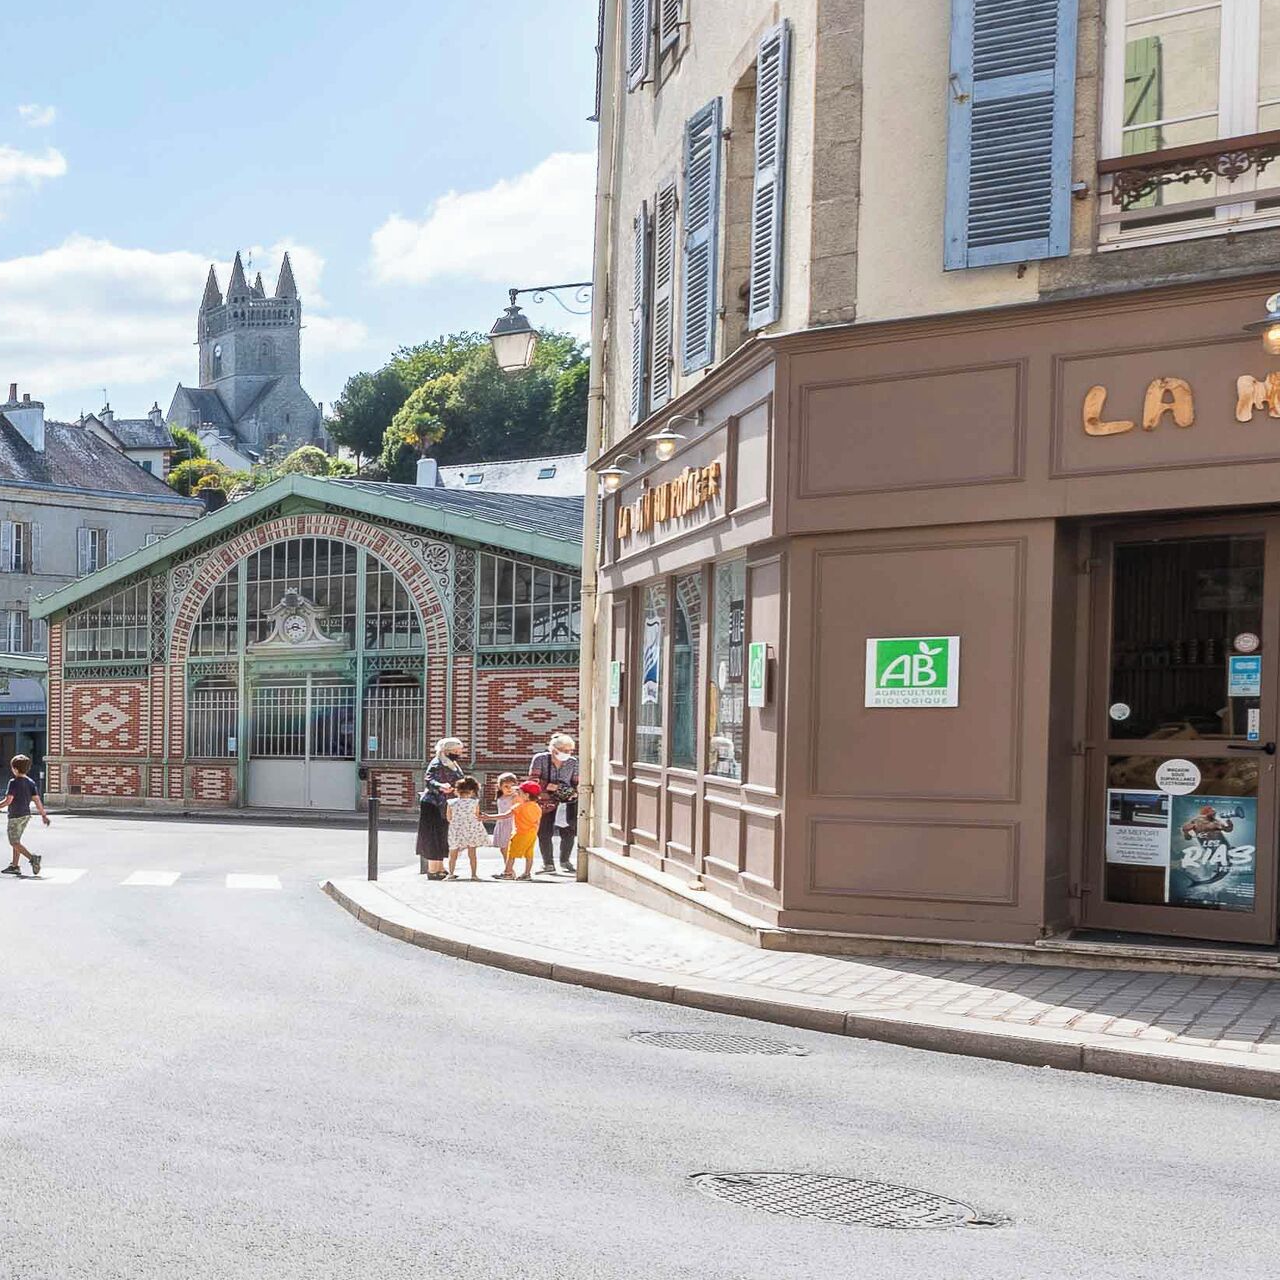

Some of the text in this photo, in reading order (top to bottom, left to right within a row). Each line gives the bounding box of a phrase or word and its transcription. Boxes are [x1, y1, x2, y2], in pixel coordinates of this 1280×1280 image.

[1083, 377, 1194, 436] LA
[880, 654, 937, 687] AB
[874, 689, 948, 697] AGRICULTURE
[874, 697, 948, 705] BIOLOGIQUE
[1182, 844, 1256, 869] RIAS
